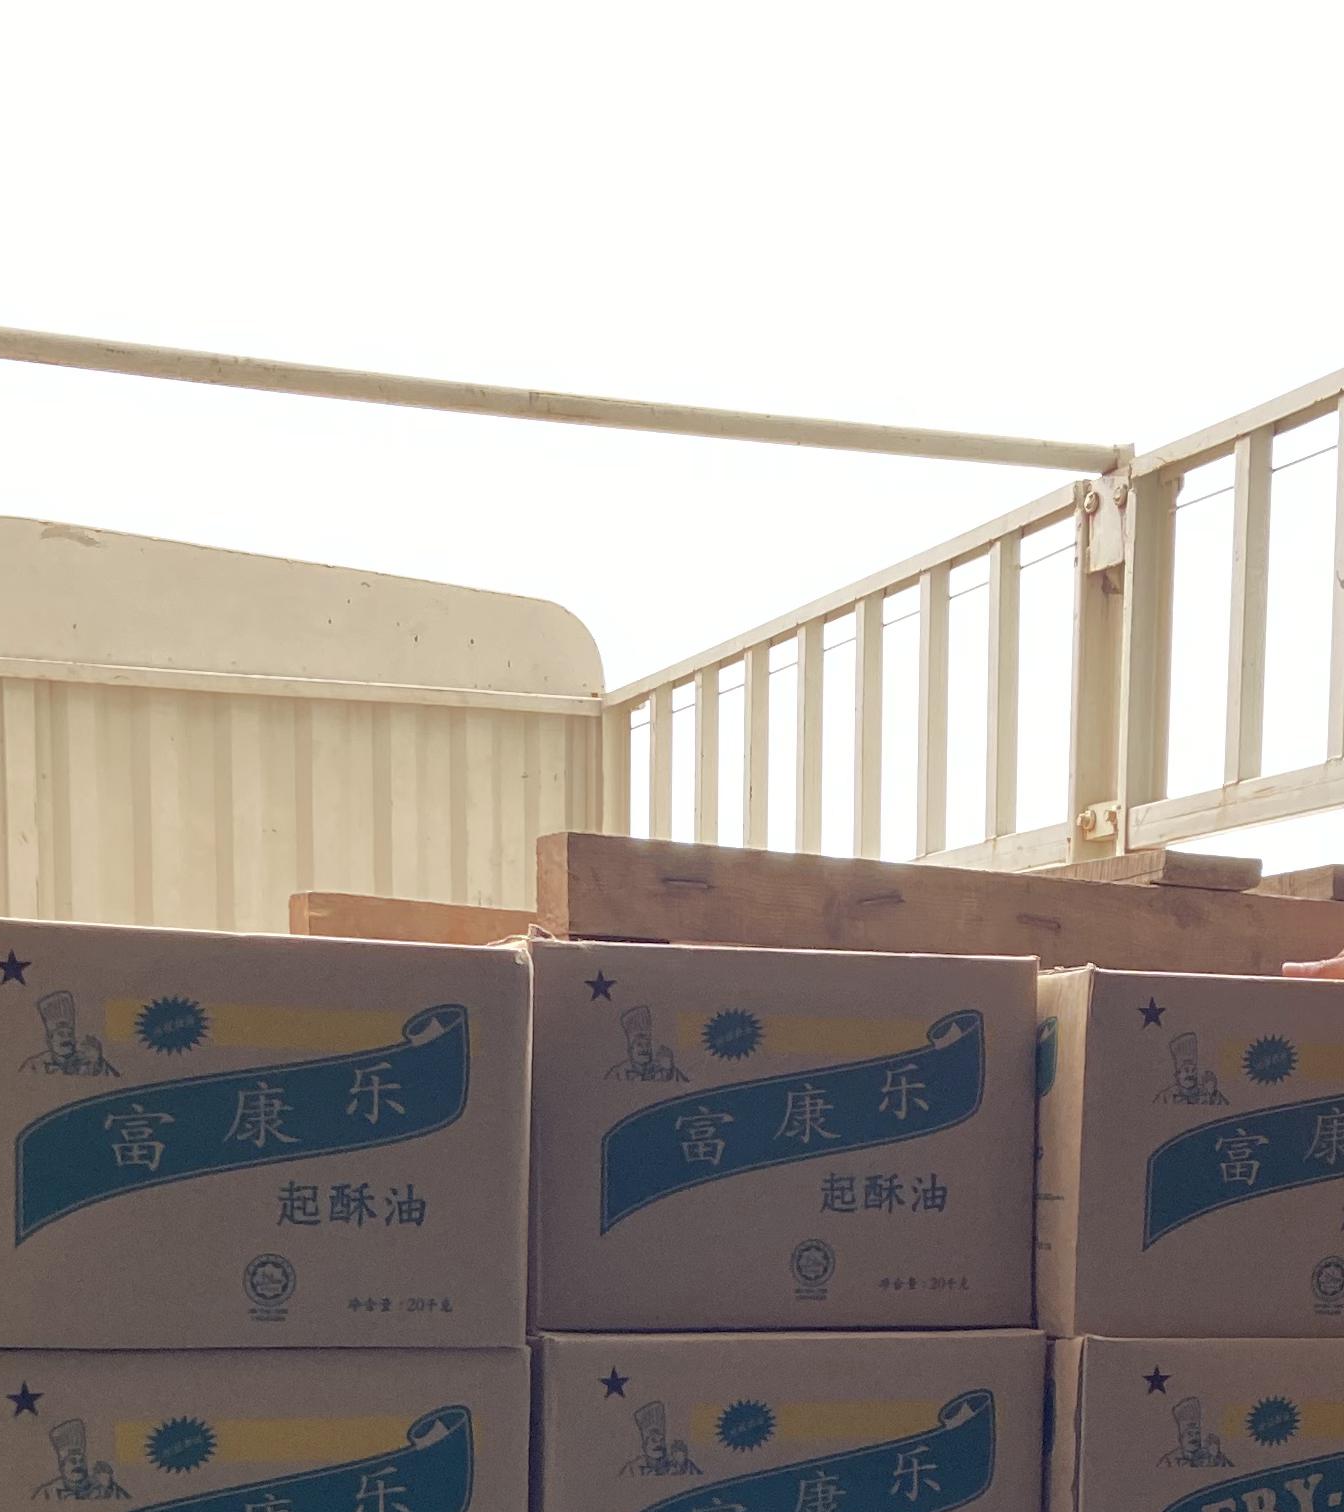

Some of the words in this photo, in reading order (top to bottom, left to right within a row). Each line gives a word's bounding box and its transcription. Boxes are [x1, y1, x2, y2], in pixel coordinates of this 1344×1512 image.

[103, 1063, 406, 1172] 富康乐
[675, 1064, 930, 1166] 富康乐
[277, 1182, 426, 1226] 起酥油
[819, 1173, 948, 1214] 起酥油
